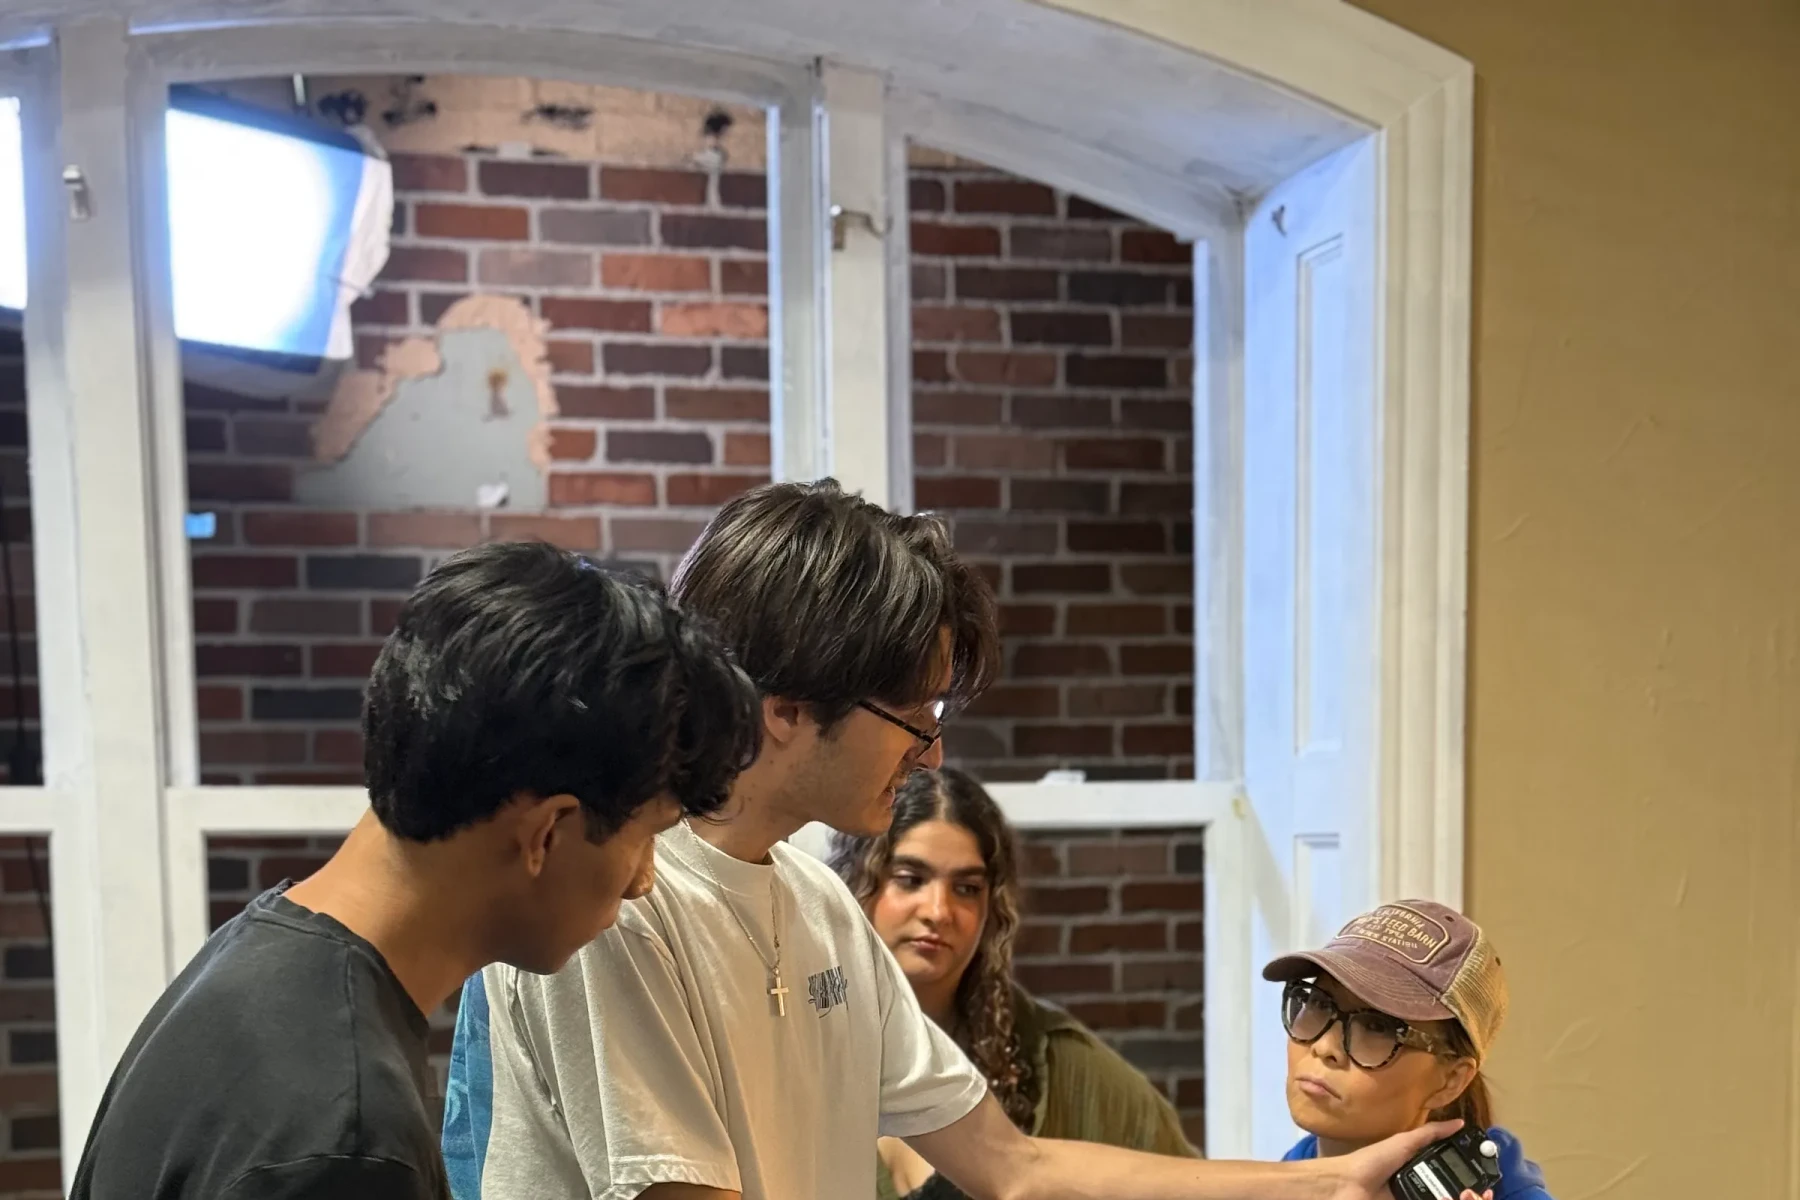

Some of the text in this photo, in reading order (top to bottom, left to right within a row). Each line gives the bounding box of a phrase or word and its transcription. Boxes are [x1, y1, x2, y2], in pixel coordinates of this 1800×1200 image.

[1376, 907, 1426, 929] CALIFORNIA
[1381, 917, 1408, 933] FEED
[1407, 928, 1438, 948] BARN
[1381, 935, 1418, 949] STATION
